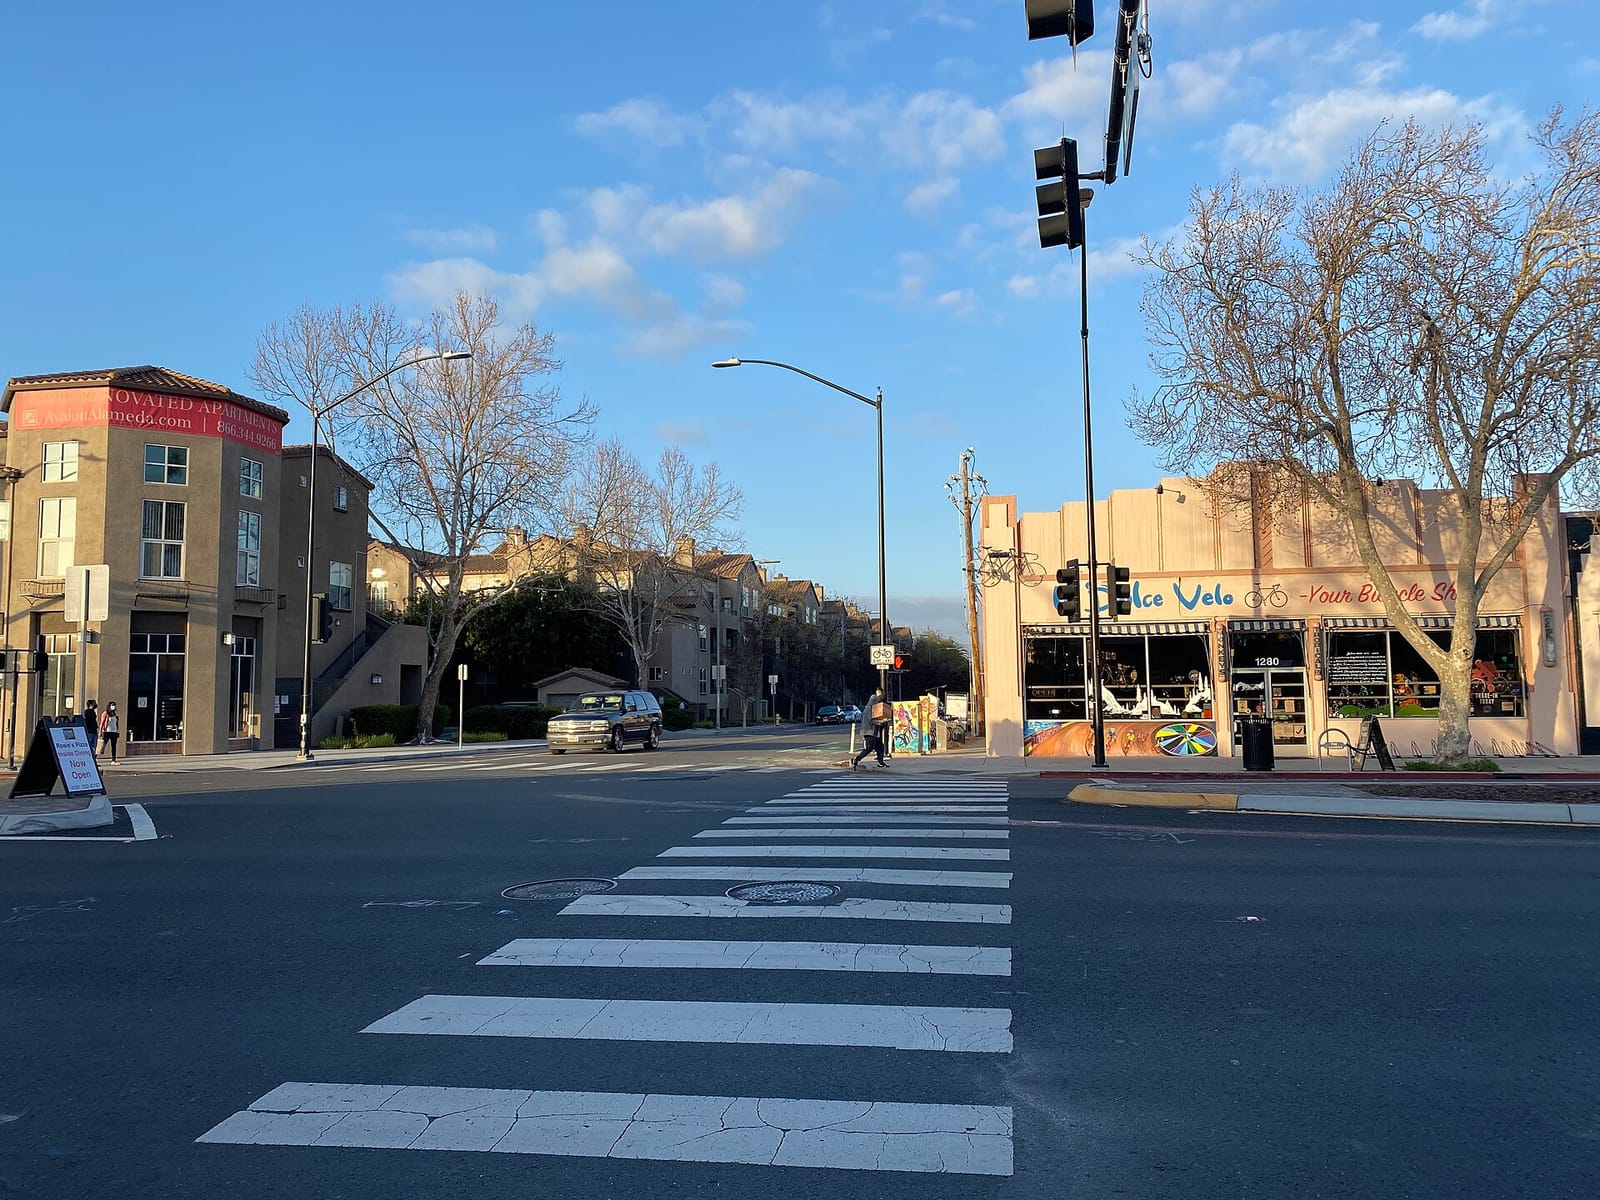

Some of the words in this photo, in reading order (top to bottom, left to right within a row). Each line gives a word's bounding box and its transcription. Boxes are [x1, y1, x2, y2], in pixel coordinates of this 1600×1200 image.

[198, 400, 278, 435] APARTMENTS
[216, 420, 277, 450] 866.344.9266
[1085, 580, 1164, 612] Dlce
[1173, 582, 1234, 611] Velo
[1255, 657, 1280, 666] 1280
[70, 760, 86, 768] Now
[72, 771, 92, 780] Open
